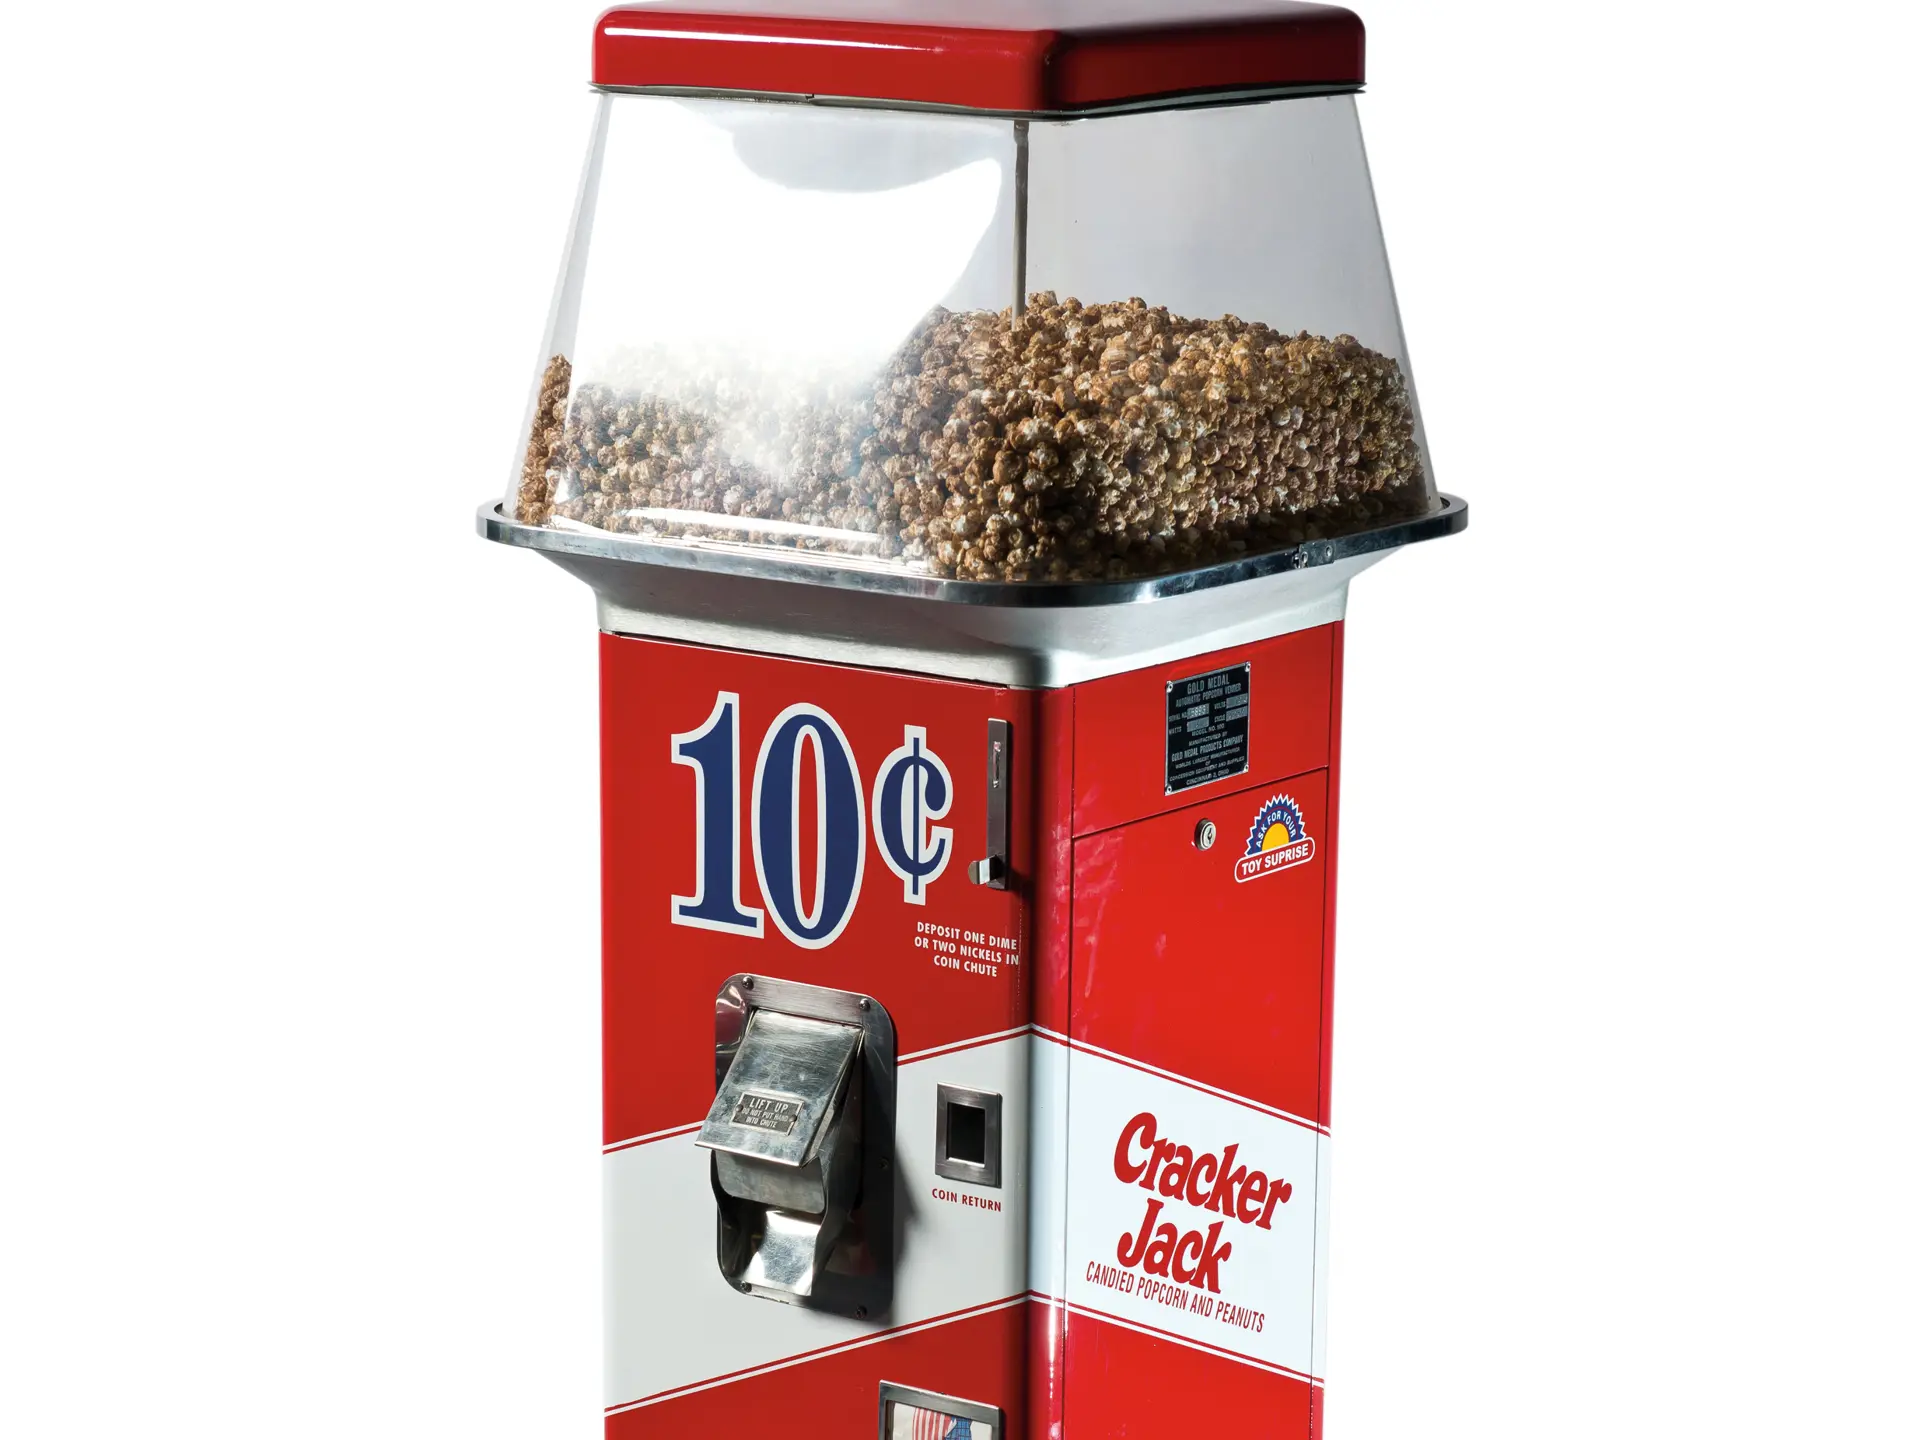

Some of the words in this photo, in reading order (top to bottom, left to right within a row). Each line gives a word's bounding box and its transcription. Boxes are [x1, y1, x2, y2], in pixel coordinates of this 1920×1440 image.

[1187, 680, 1204, 694] GOLD
[1208, 674, 1229, 689] MEDAL
[1176, 694, 1200, 707] AUTOMATIC
[1203, 688, 1223, 700] POPCORN
[1169, 727, 1181, 735] WATTS
[1192, 728, 1207, 736] MODEL
[1172, 752, 1183, 762] GOLD
[1184, 748, 1198, 758] MEDAL
[1200, 741, 1222, 754] PRODUCTS
[1223, 734, 1243, 747] COMPANY
[1169, 770, 1194, 781] CONCESSION
[1196, 764, 1218, 774] EQUIPMENT
[1227, 756, 1244, 767] SUPPLIES
[671, 690, 953, 950] 10¢
[1256, 824, 1267, 847] ASK
[1267, 811, 1281, 825] FOR
[1283, 812, 1296, 838] YOUR
[1242, 858, 1262, 875] TOY
[1265, 843, 1308, 868] SUPRISE
[917, 921, 960, 940] DEPOSIT
[964, 930, 985, 944] ONE
[989, 935, 1017, 950] DIME
[914, 936, 928, 949] OR
[933, 940, 956, 953] TWO
[960, 945, 1002, 963] NICKELS
[1006, 954, 1019, 966] IN
[934, 955, 960, 970] COIN
[964, 961, 997, 977] CHUTE
[750, 1098, 772, 1110] LIFT
[774, 1103, 788, 1113] UP
[762, 1111, 774, 1119] PUT
[760, 1119, 778, 1128] CHUTE
[1114, 1112, 1292, 1230] Cracker
[932, 1188, 957, 1203] COIN
[962, 1194, 1001, 1212] RETURN
[1117, 1198, 1232, 1294] Jack
[1086, 1261, 1134, 1293] CANDIED
[1136, 1276, 1189, 1310] POPCORN
[1190, 1294, 1213, 1317] AND
[1216, 1300, 1265, 1333] PEANUTS
